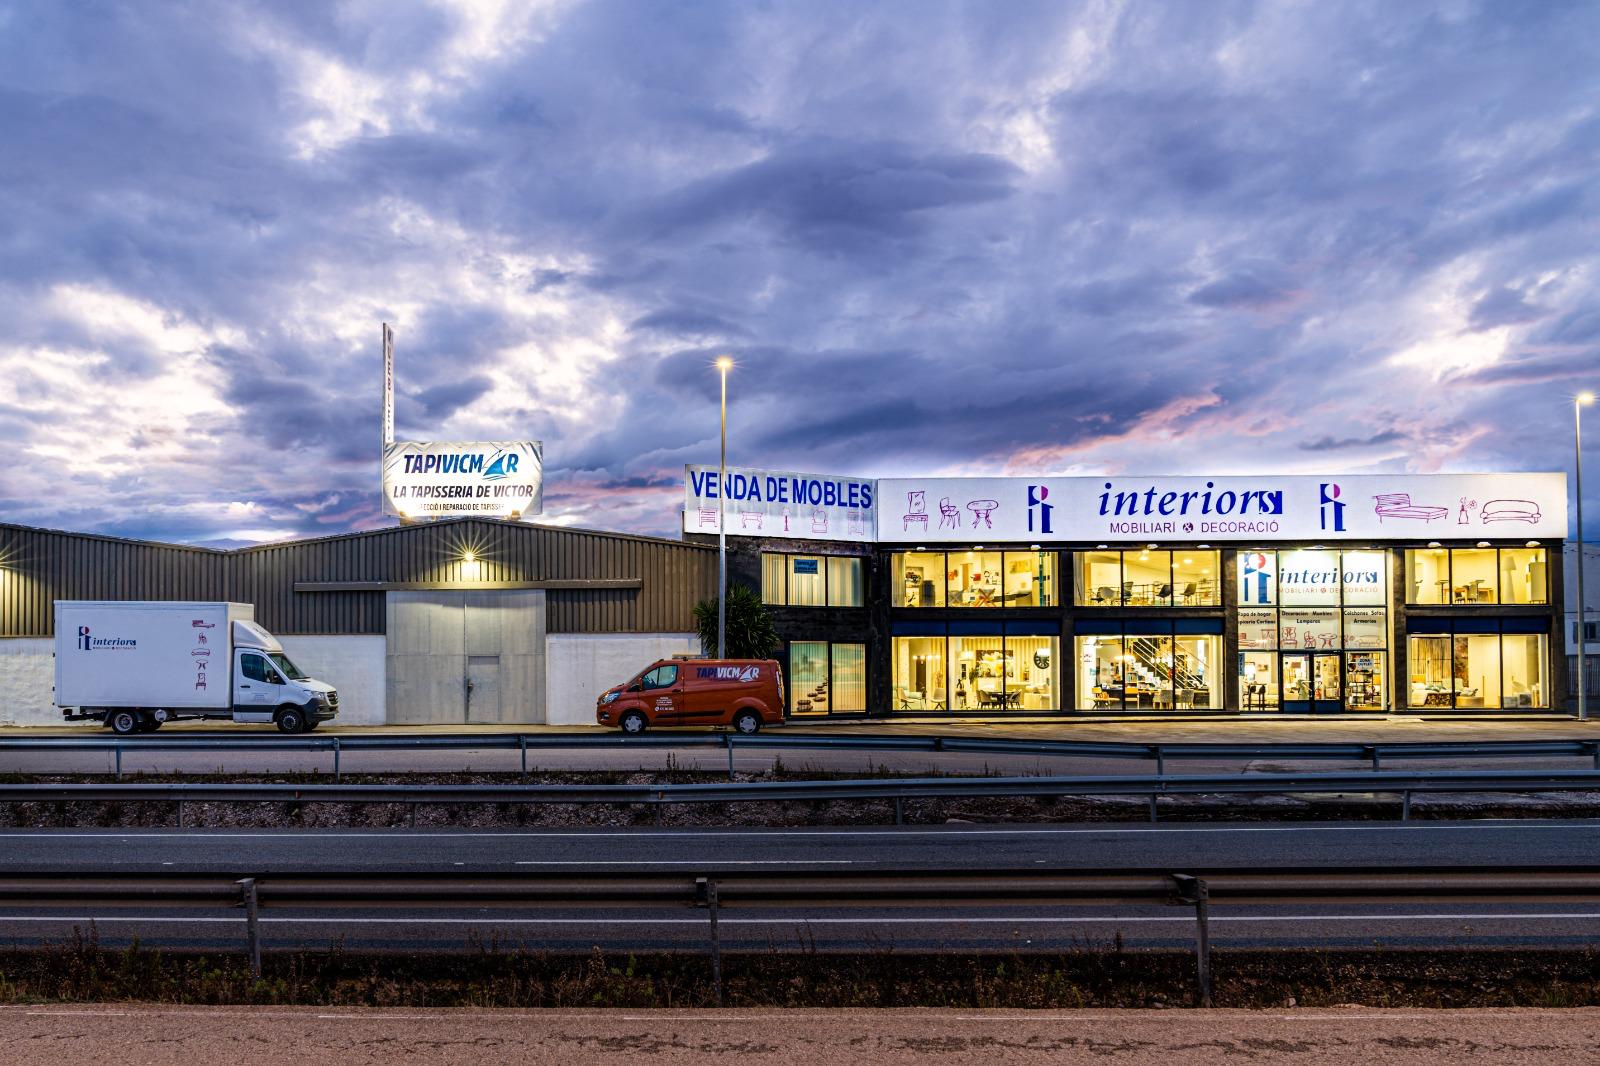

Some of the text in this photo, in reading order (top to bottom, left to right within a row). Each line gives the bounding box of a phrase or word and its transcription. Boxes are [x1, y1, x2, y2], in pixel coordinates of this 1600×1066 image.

[393, 484, 533, 498] LA TAPISSERIA DE VICTOR
[690, 471, 873, 509] VENDA DE MOBLES
[1099, 482, 1283, 516] interiors
[473, 503, 480, 511] DE
[1109, 522, 1176, 534] MOBILIARI
[1201, 520, 1279, 533] DECORACIÓ
[1279, 567, 1378, 584] interiors
[92, 637, 137, 646] interiors
